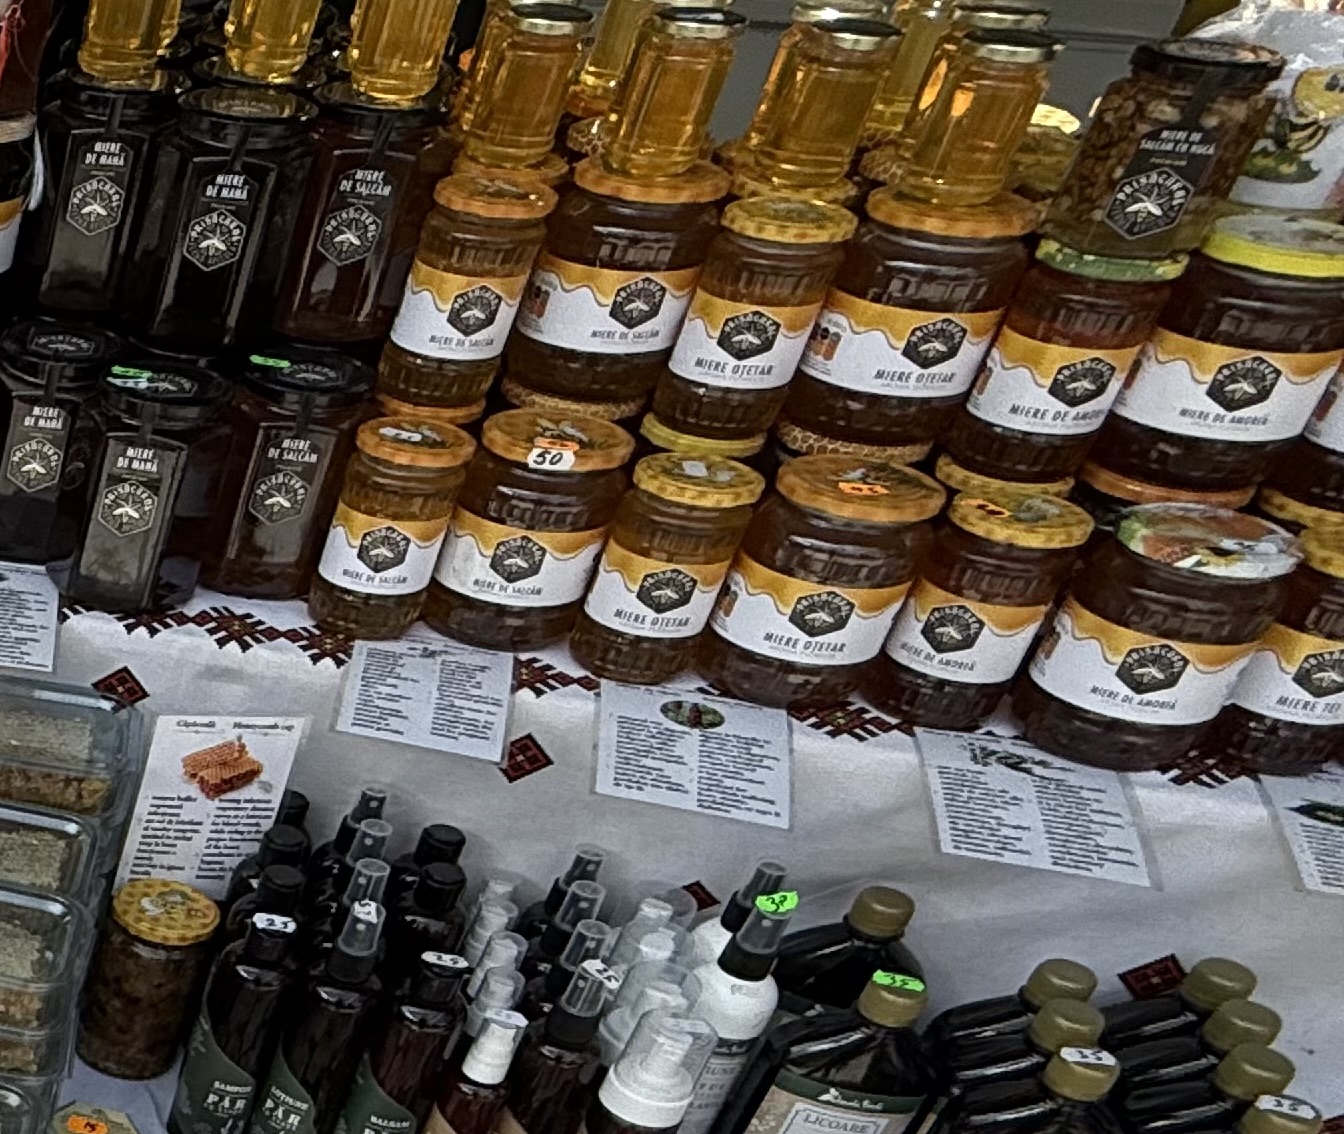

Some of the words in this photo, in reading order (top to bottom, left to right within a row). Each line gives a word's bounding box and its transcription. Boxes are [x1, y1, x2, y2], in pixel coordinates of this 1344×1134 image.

[694, 357, 727, 374] MIERE
[874, 369, 912, 382] MIERE
[533, 452, 564, 466] 50
[613, 608, 648, 624] MIERE
[764, 632, 800, 649] MIERE
[803, 1113, 869, 1134] LICOARE
